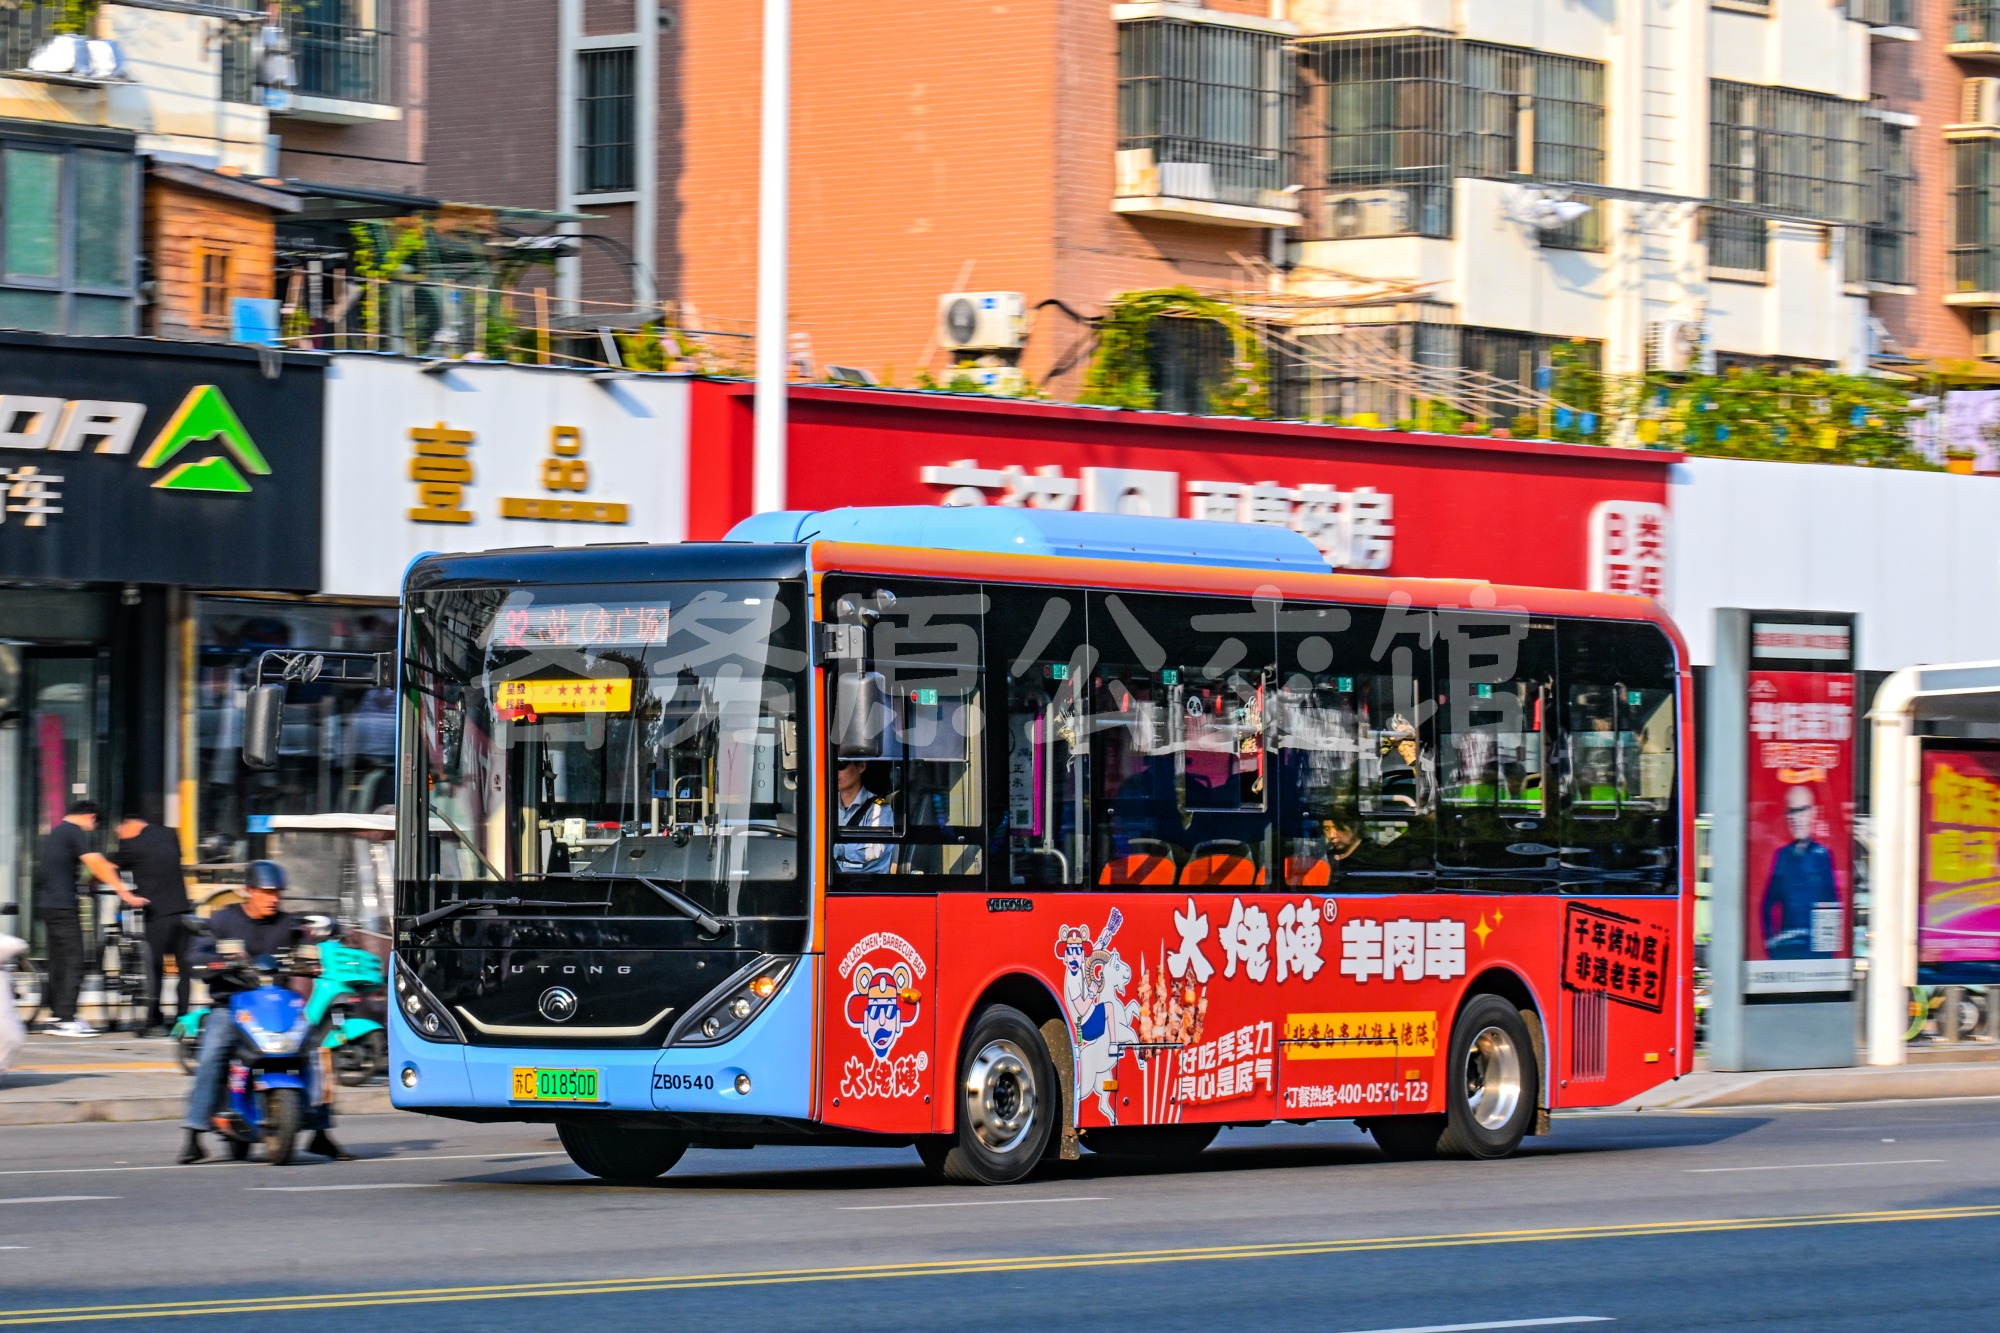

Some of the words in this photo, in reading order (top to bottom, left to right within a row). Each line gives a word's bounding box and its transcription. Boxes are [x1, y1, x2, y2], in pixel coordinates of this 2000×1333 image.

[0, 466, 65, 527] 车
[504, 610, 529, 646] 32
[840, 961, 851, 976] DA
[848, 946, 862, 964] LAO
[861, 935, 878, 952] CHEN
[882, 934, 914, 960] BARBECUE
[912, 957, 925, 977] BAR
[1341, 919, 1466, 982] 羊肉串
[1574, 917, 1658, 965] 千年烤功底
[487, 965, 632, 974] YUTONG
[1575, 951, 1659, 999] 非遗老手艺
[1178, 1021, 1273, 1075] 好吃凭实力
[654, 1074, 714, 1090] ZB0540
[1177, 1058, 1273, 1102] 良心是底气
